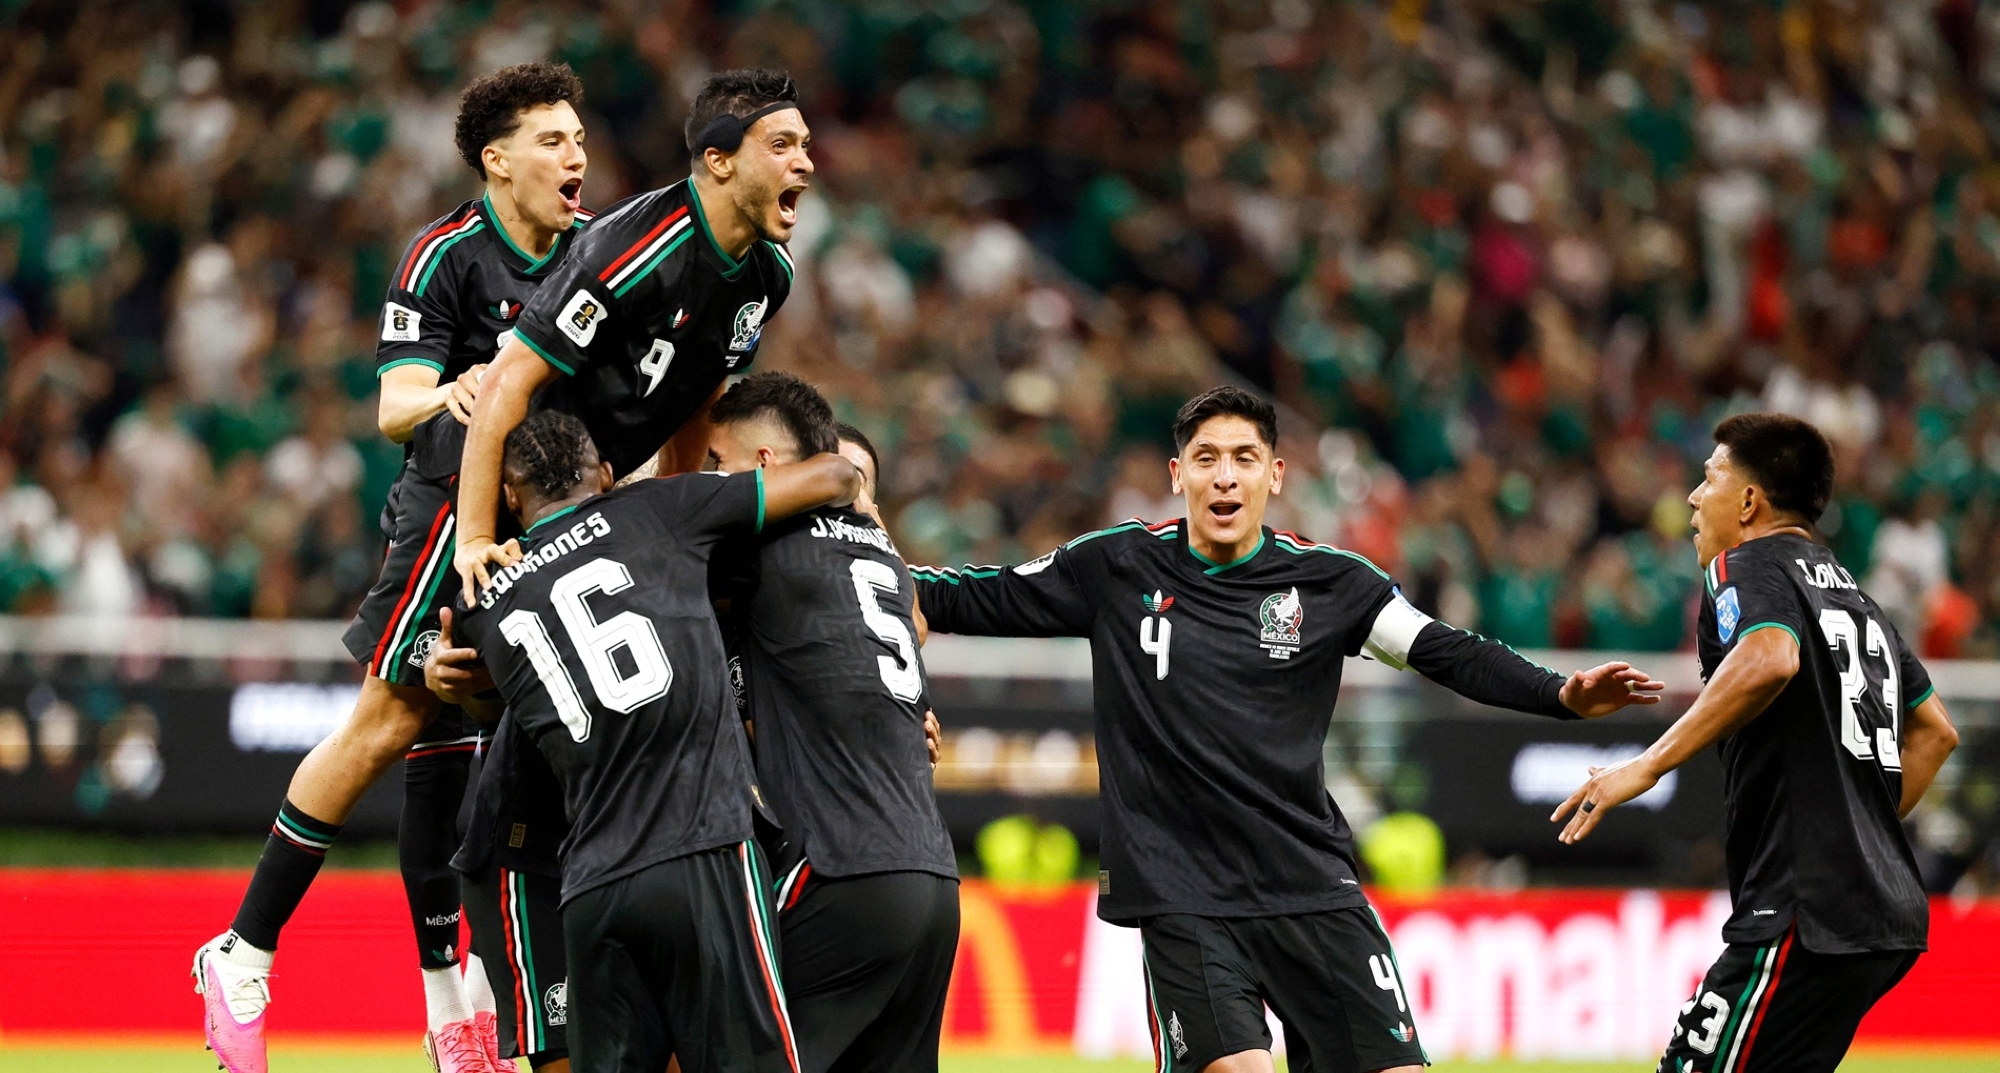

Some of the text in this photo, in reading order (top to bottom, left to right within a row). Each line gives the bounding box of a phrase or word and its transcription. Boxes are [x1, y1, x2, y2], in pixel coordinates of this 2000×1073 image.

[640, 338, 676, 398] 9
[498, 557, 674, 743] 16
[849, 558, 923, 705] 5
[1139, 616, 1173, 681] 4
[1262, 630, 1299, 642] MÉXICO
[1818, 608, 1903, 773] 23
[1368, 953, 1406, 1013] 4
